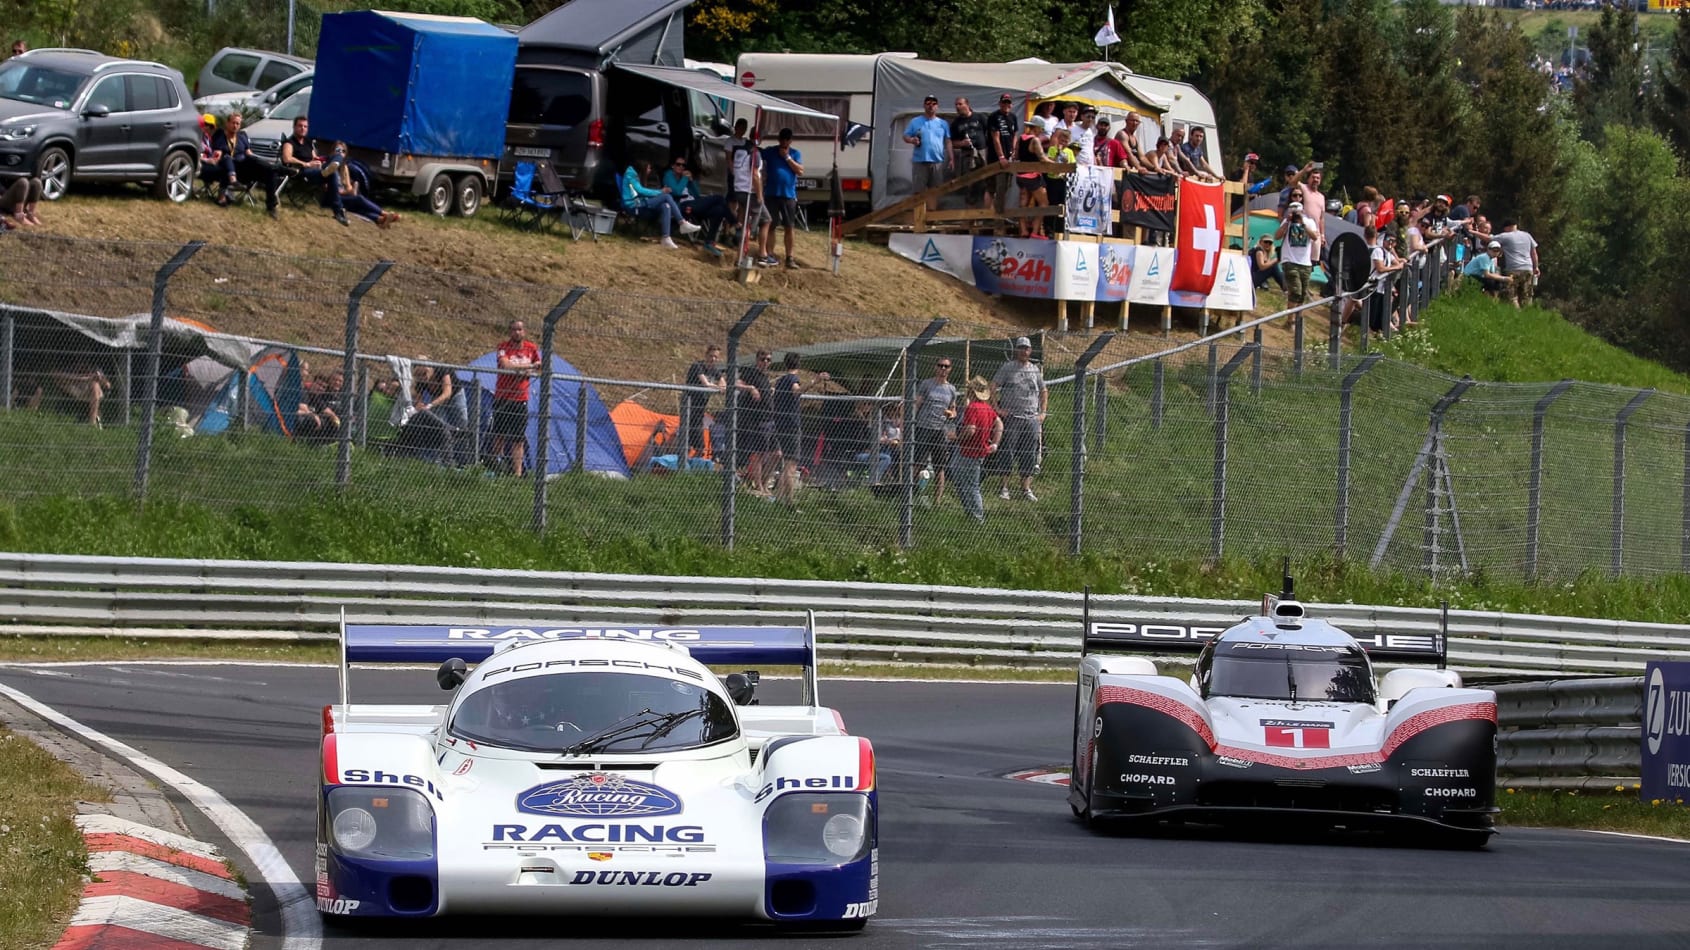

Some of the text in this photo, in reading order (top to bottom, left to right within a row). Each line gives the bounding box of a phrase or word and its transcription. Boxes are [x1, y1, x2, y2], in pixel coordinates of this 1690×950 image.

[1001, 256, 1052, 282] 24h
[447, 628, 701, 640] RACING
[1231, 642, 1352, 655] PORSCHE
[482, 659, 705, 681] PORSCHE
[1281, 728, 1304, 748] 1
[1128, 754, 1189, 766] SCHAEFFLER
[1120, 773, 1176, 785] CHOPARD
[1411, 768, 1470, 778] SCHAEFFLER
[344, 769, 444, 802] Shell
[754, 775, 854, 804] Shell
[1424, 787, 1477, 797] CHOPARD
[552, 788, 647, 807] Racing
[492, 824, 705, 843] RACING
[569, 870, 713, 887] DUNLOP
[316, 896, 360, 915] DUNLOP
